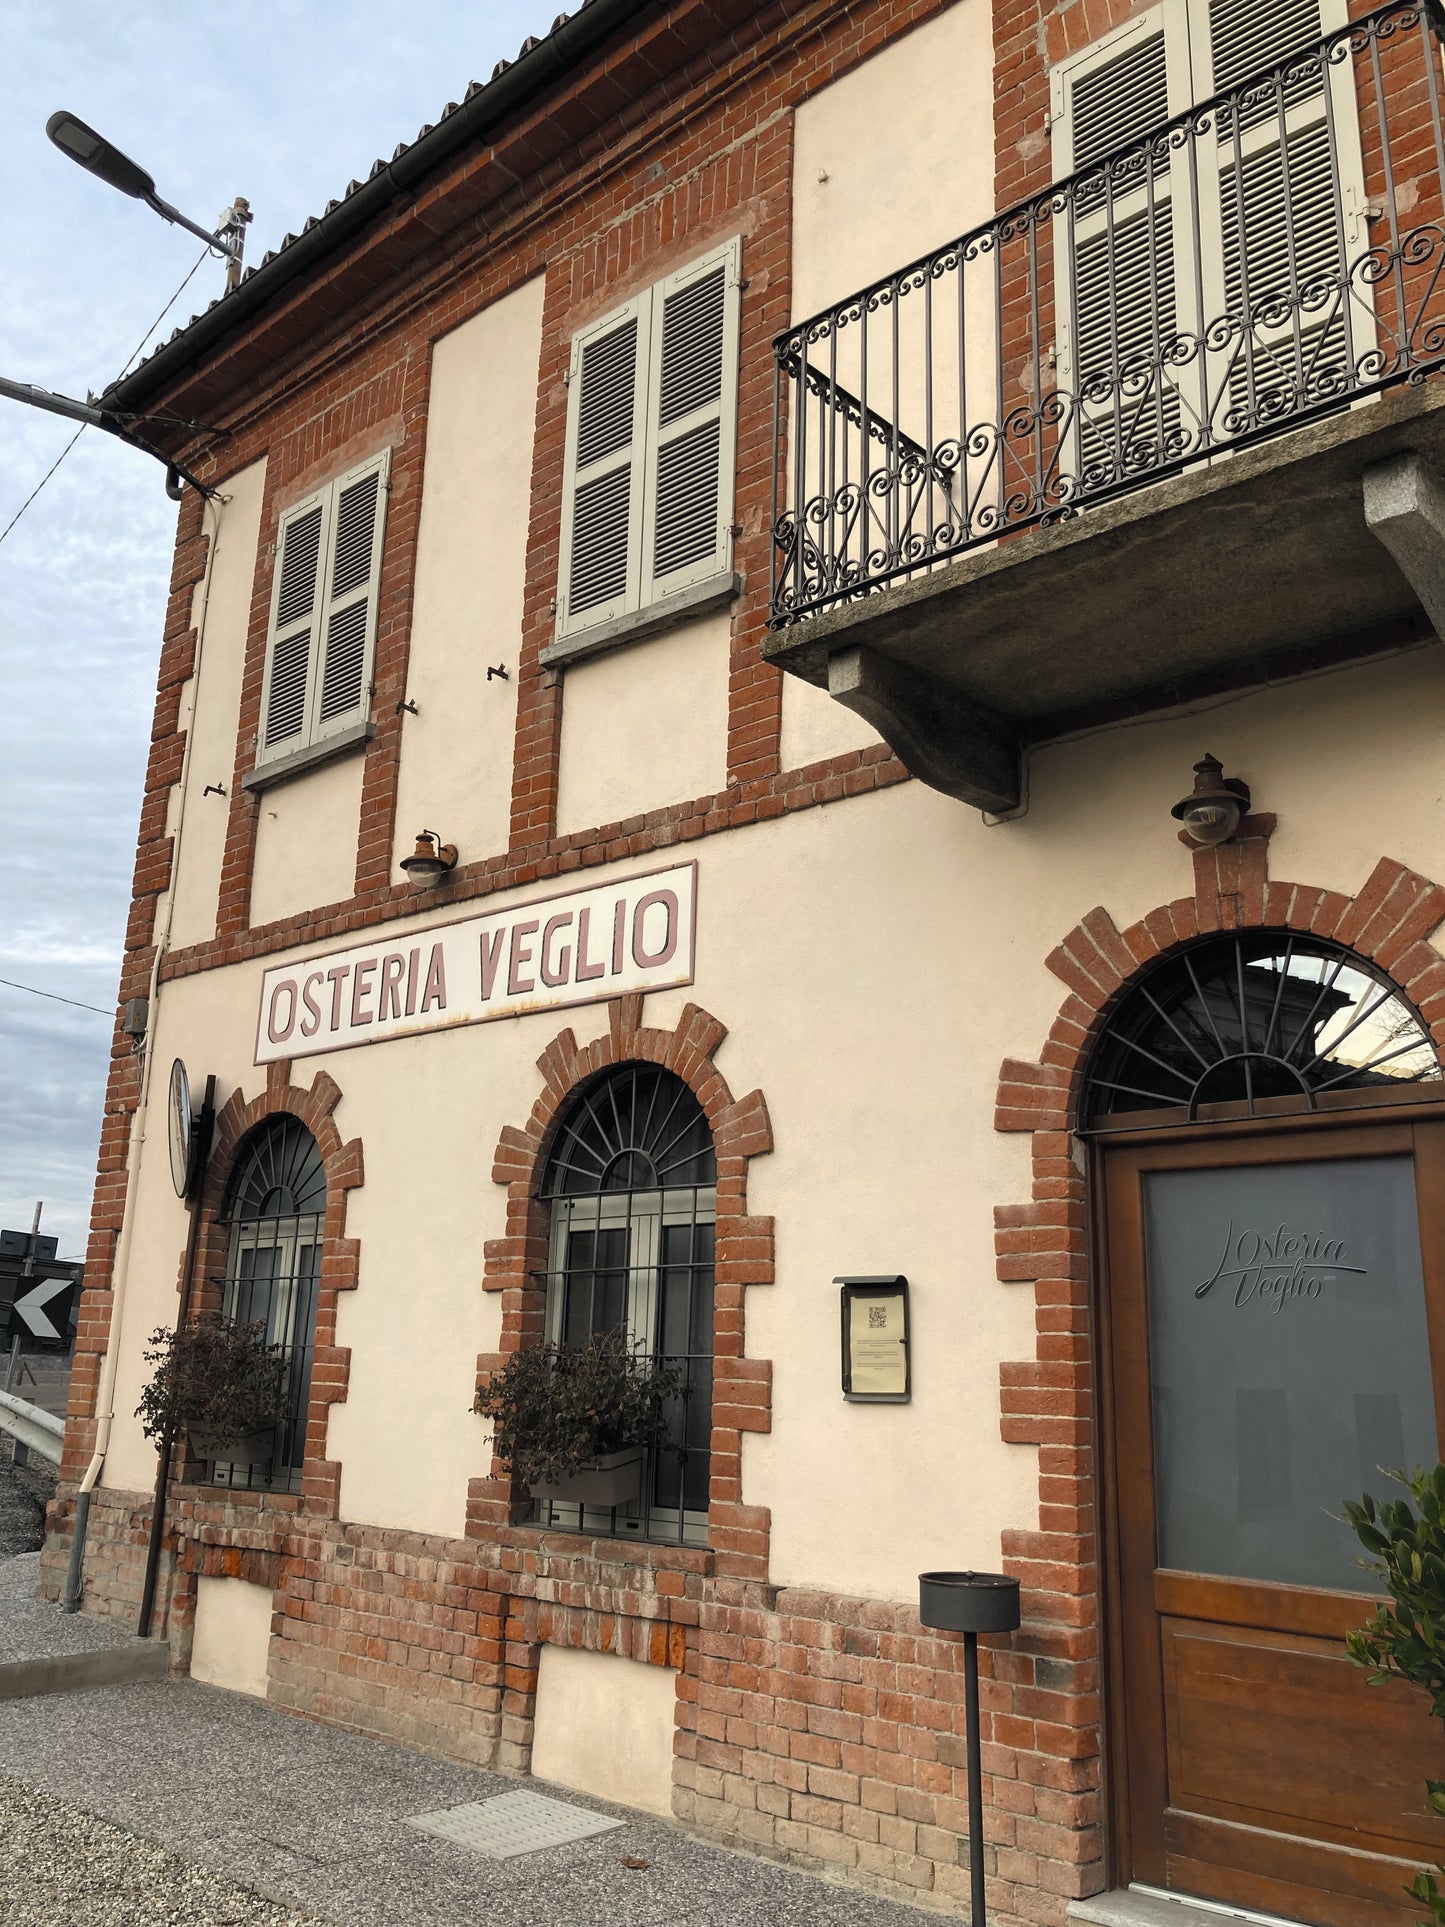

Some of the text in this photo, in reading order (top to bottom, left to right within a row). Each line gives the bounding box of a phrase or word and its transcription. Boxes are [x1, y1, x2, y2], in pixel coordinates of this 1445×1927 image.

[268, 889, 679, 1044] OSTERIA VEGLIO
[1234, 1257, 1322, 1314] Veglio
